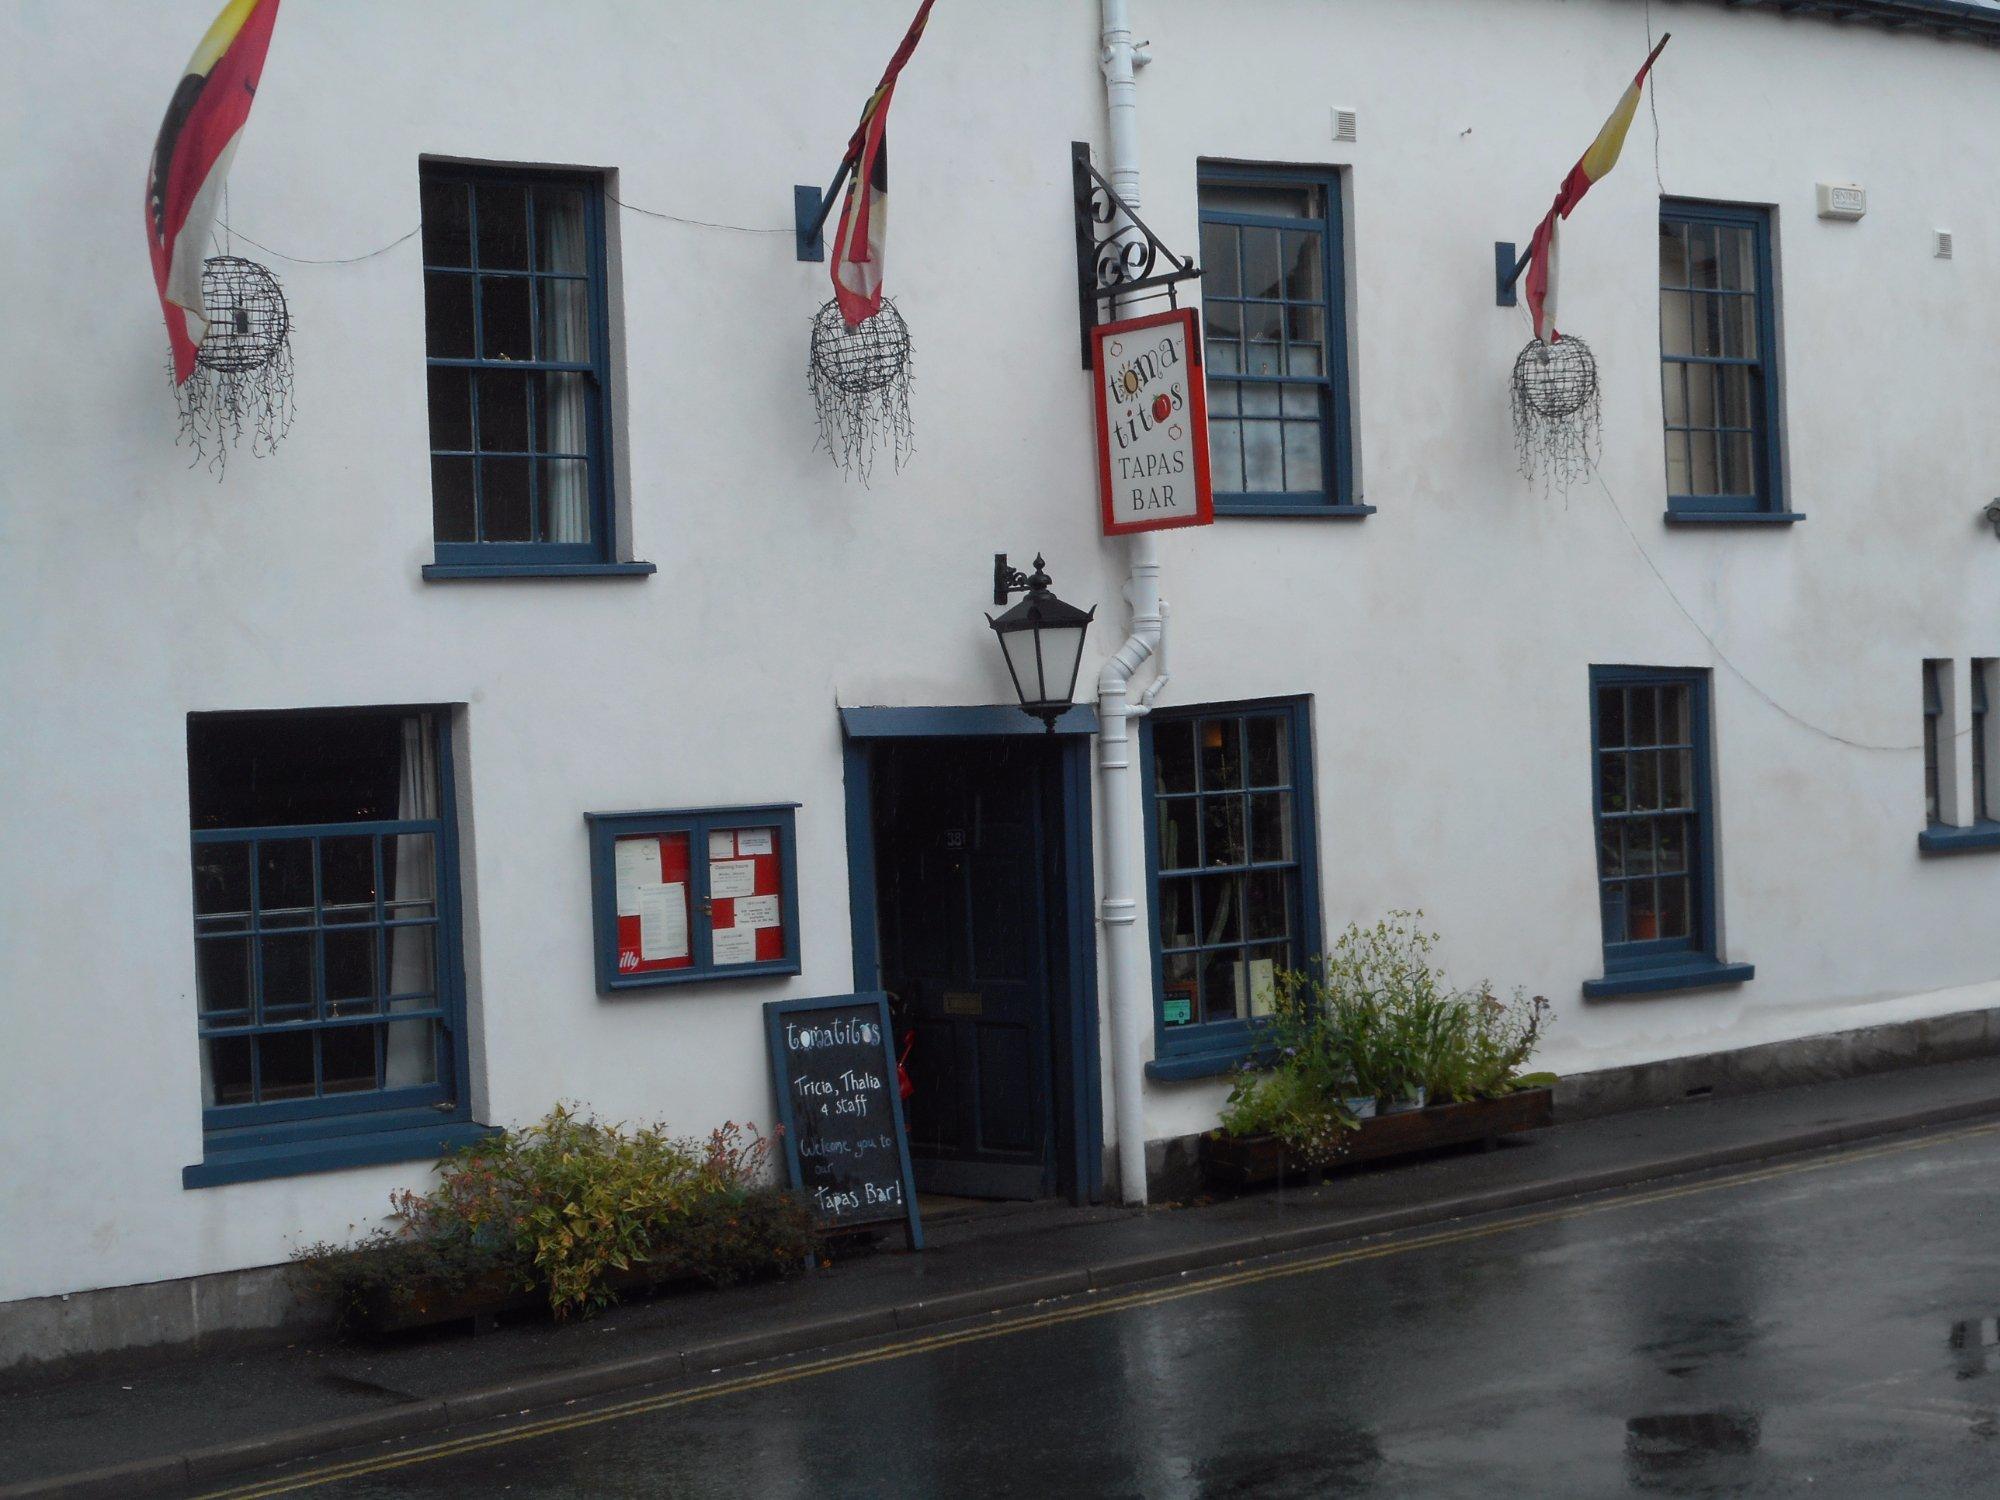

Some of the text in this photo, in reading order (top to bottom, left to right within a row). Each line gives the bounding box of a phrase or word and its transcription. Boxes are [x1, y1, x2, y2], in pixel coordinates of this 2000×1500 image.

[1113, 382, 1183, 449] titos
[1118, 450, 1184, 480] TAPAS
[1131, 485, 1176, 511] BAR
[619, 951, 639, 970] illy
[794, 1069, 881, 1096] Tricia, Thalia
[836, 1094, 868, 1117] staff
[854, 1138, 877, 1158] you
[880, 1133, 893, 1148] to
[815, 1162, 834, 1175] our
[814, 1180, 902, 1215] Tapas Bar!
